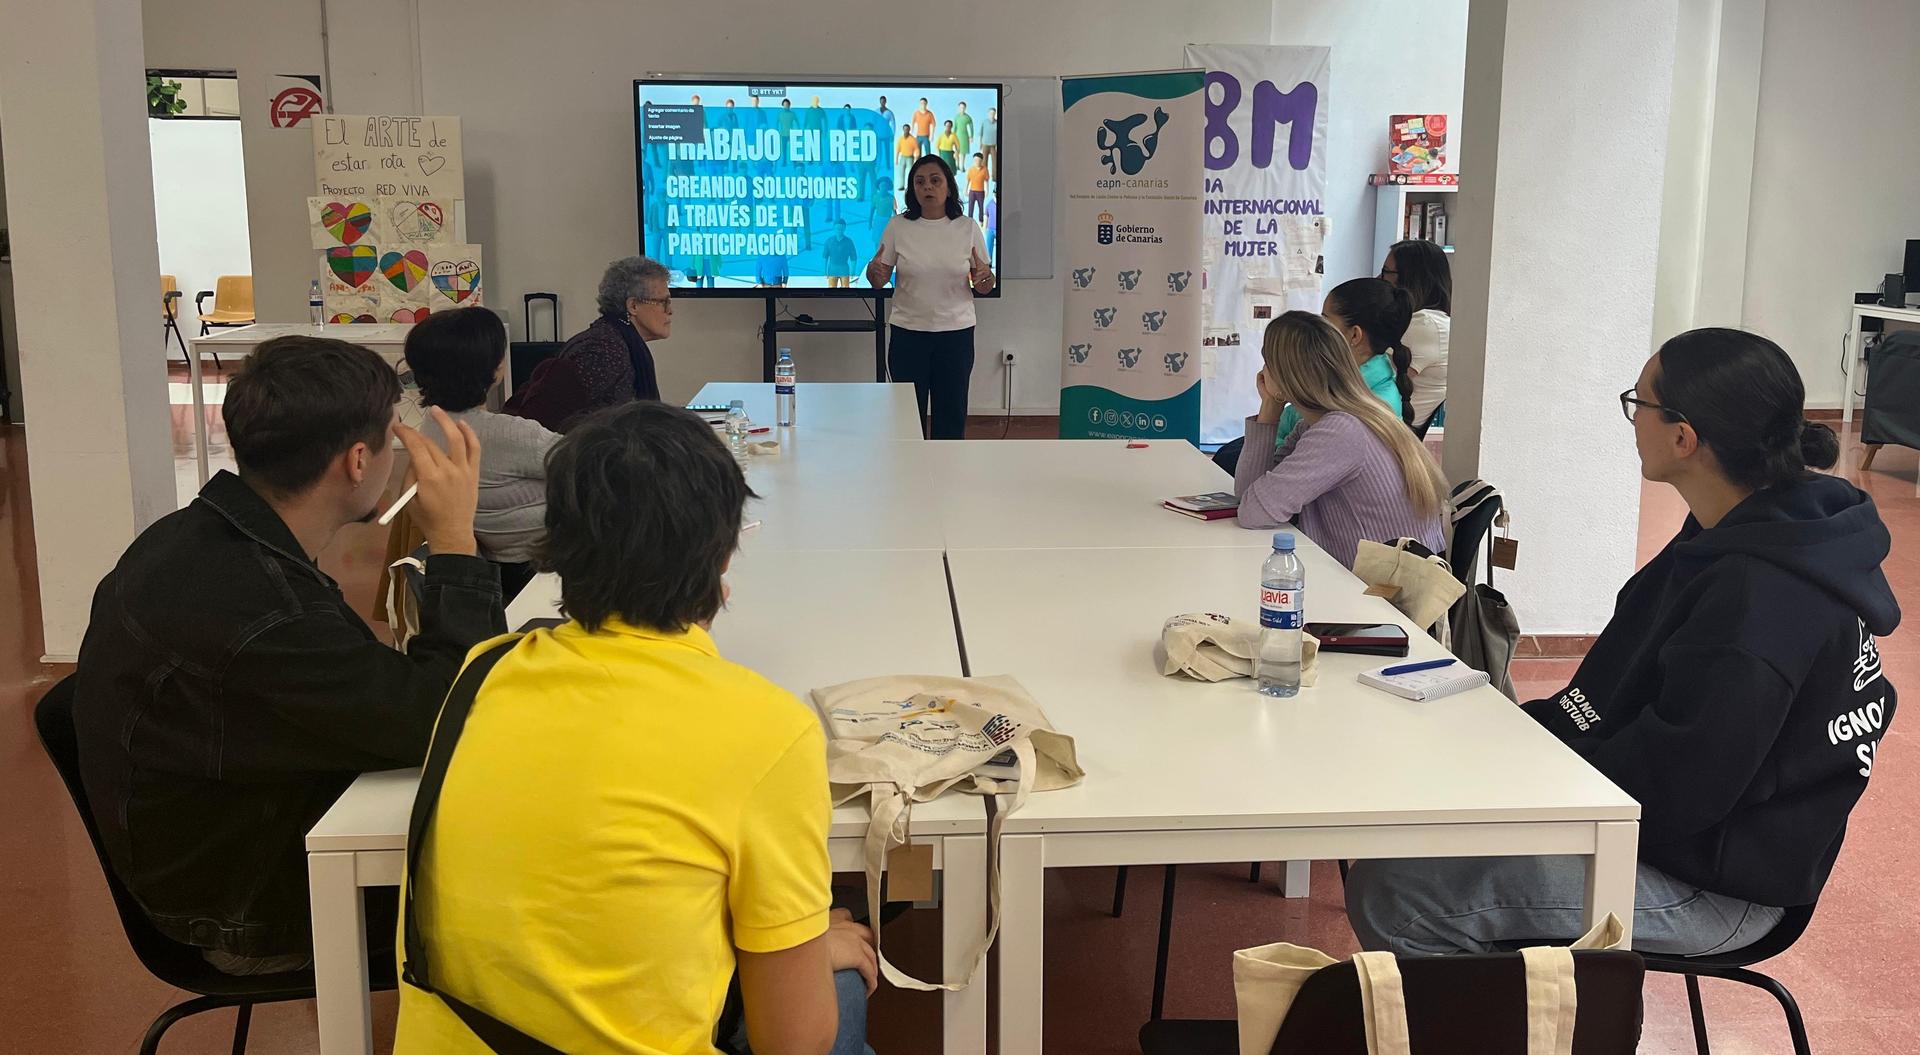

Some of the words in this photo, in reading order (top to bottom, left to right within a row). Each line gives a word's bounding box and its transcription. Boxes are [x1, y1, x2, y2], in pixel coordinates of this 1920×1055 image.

[325, 119, 350, 145] El
[364, 116, 421, 147] ARTE
[428, 121, 447, 147] de
[789, 129, 821, 162] EN
[830, 130, 877, 162] RED
[332, 152, 367, 172] estar
[381, 153, 405, 169] rota
[322, 184, 365, 195] PROYECTO
[376, 184, 396, 196] RED
[402, 185, 430, 196] VIVA
[666, 175, 747, 199] CREANDO
[752, 176, 858, 200] SOLUCIONES
[1096, 179, 1169, 190] eapn-canarias
[667, 204, 680, 227] A
[685, 200, 750, 227] TRAVÉS
[755, 205, 778, 227] DE
[783, 205, 805, 228] LA
[1204, 199, 1324, 215] INTERNACIONAL
[1116, 225, 1155, 234] Gobierno
[1224, 220, 1243, 235] DE
[1256, 218, 1278, 234] LA
[668, 229, 799, 256] PARTICIPACIÓN
[1126, 235, 1163, 244] Canarias
[1225, 241, 1278, 257] MUJER
[1559, 694, 1590, 731] DISTURB
[1568, 687, 1586, 703] DO
[1579, 701, 1602, 723] NOT
